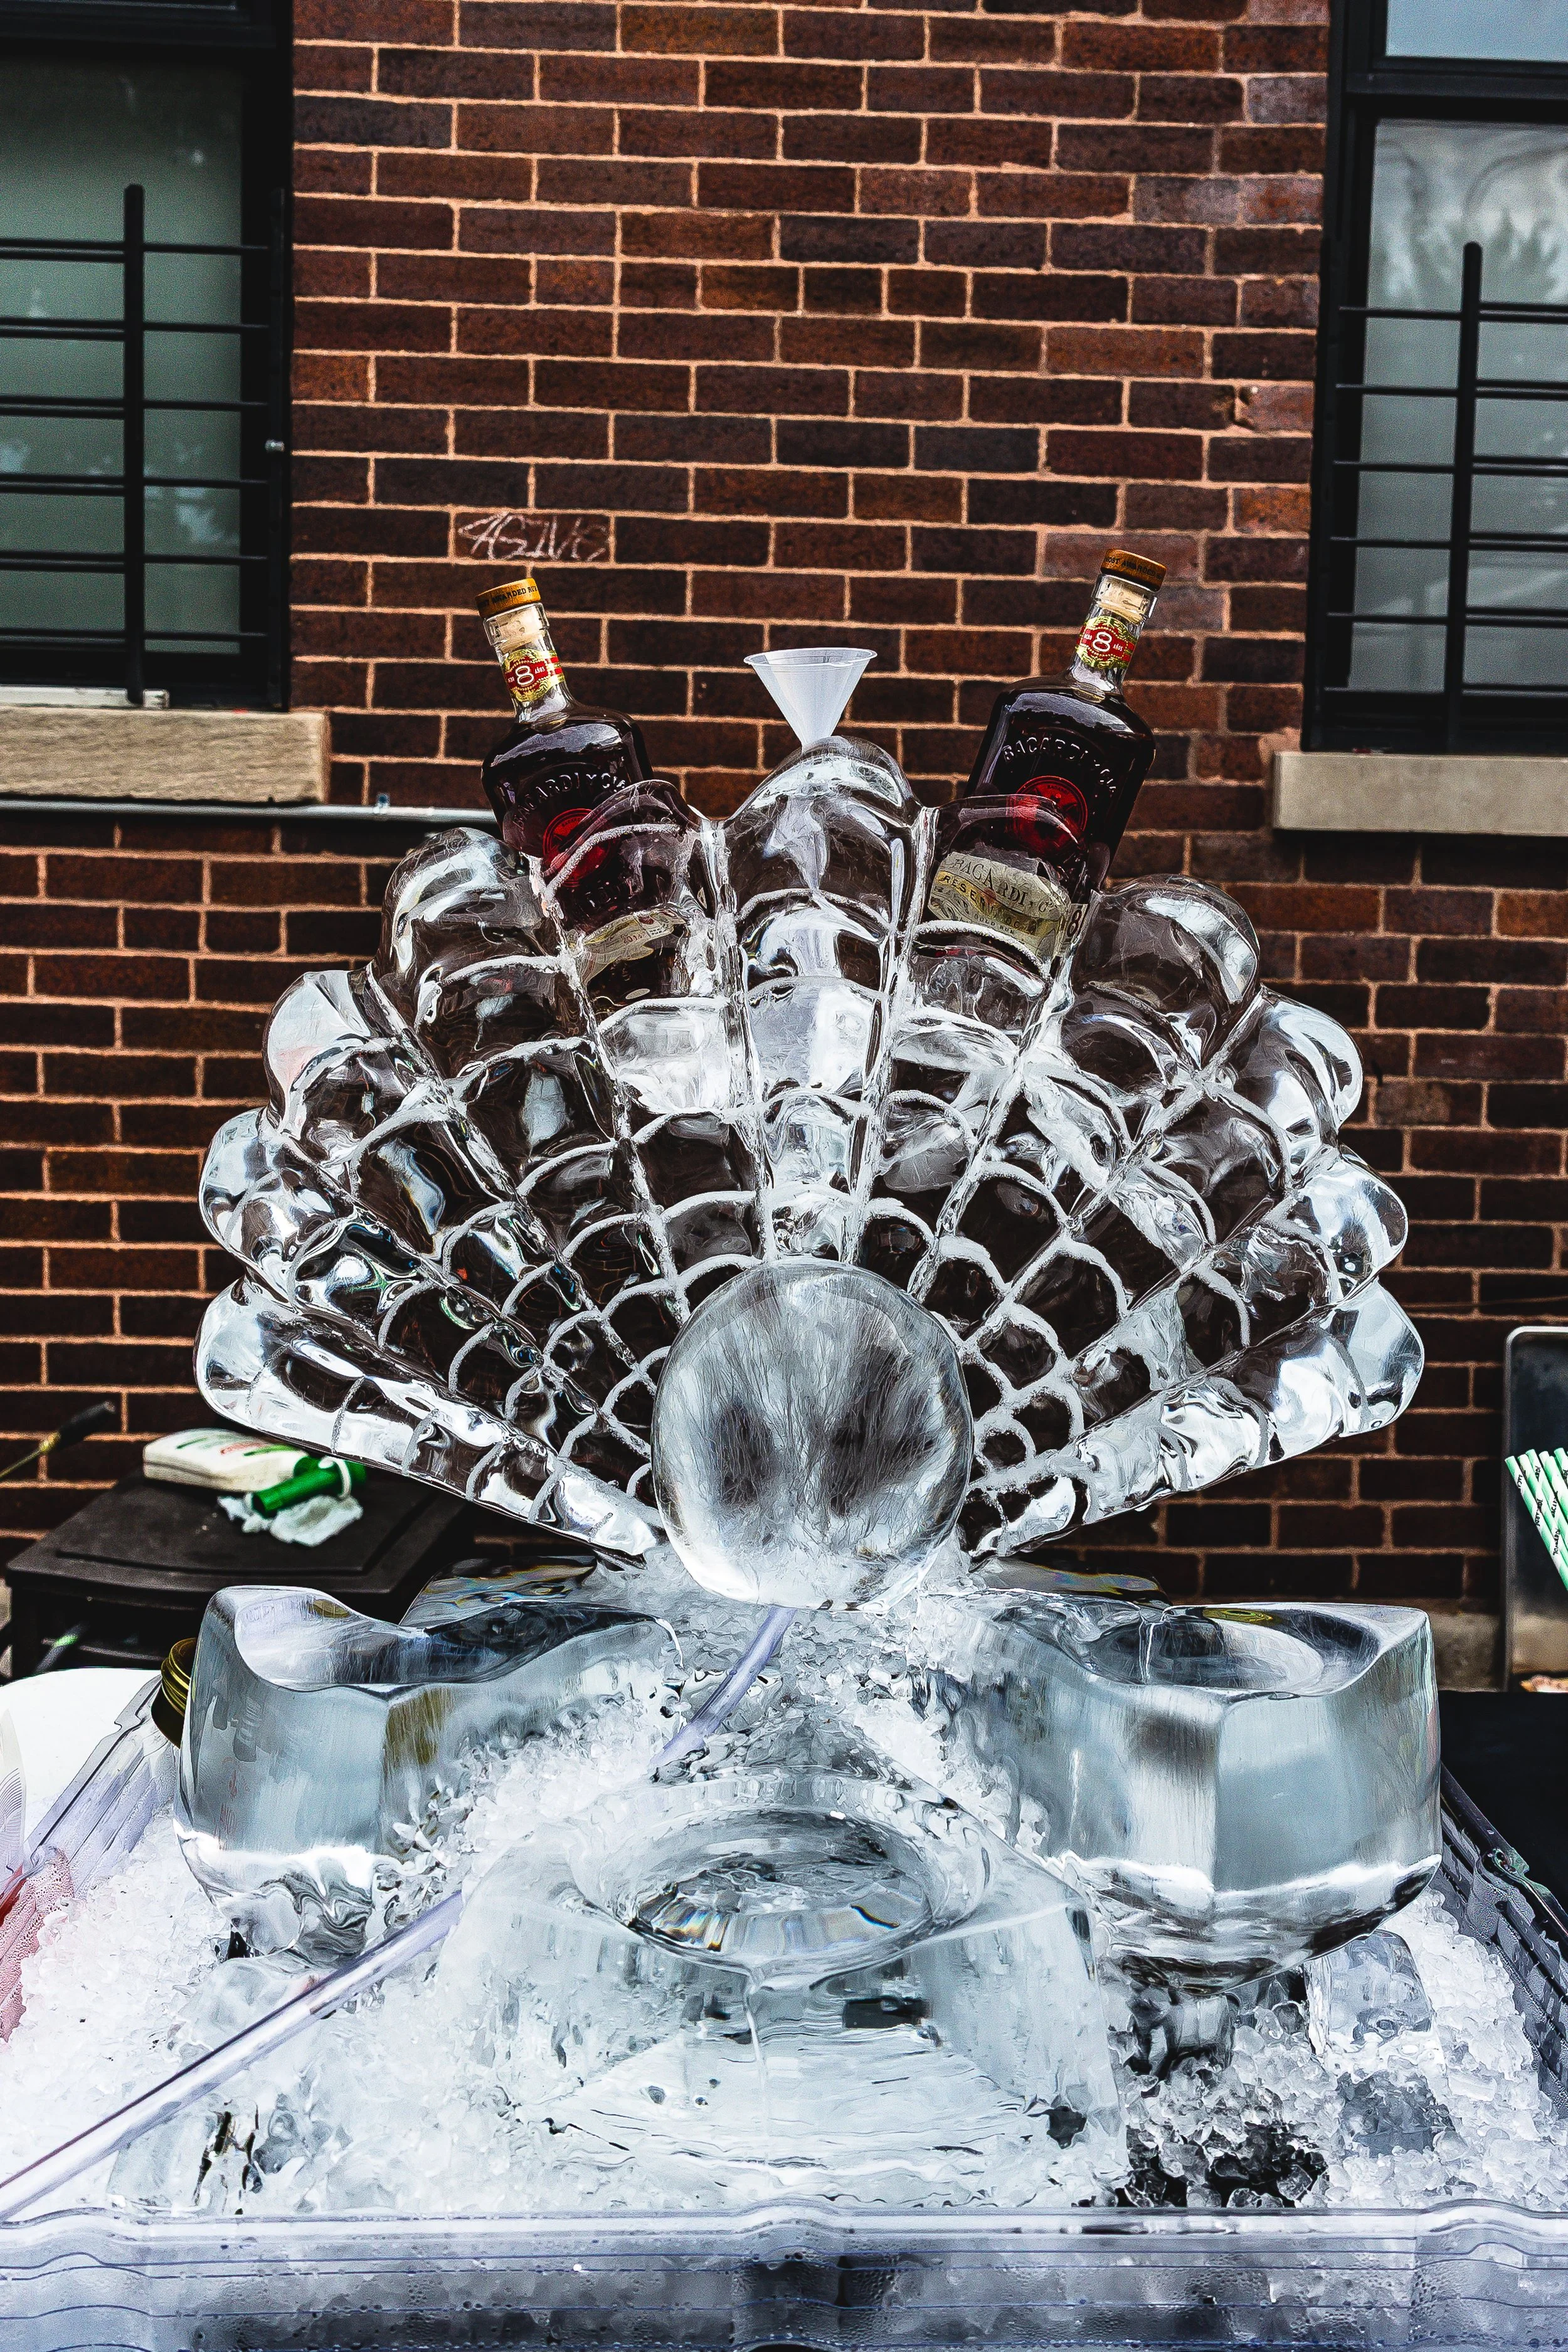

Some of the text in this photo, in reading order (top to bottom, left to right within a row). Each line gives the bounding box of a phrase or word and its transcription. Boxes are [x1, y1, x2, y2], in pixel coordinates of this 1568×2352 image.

[1092, 631, 1113, 652] 8
[515, 665, 534, 686] 8
[1002, 737, 1089, 763] BACARDI
[513, 772, 581, 837] BACARDI
[1067, 909, 1083, 936] 8
